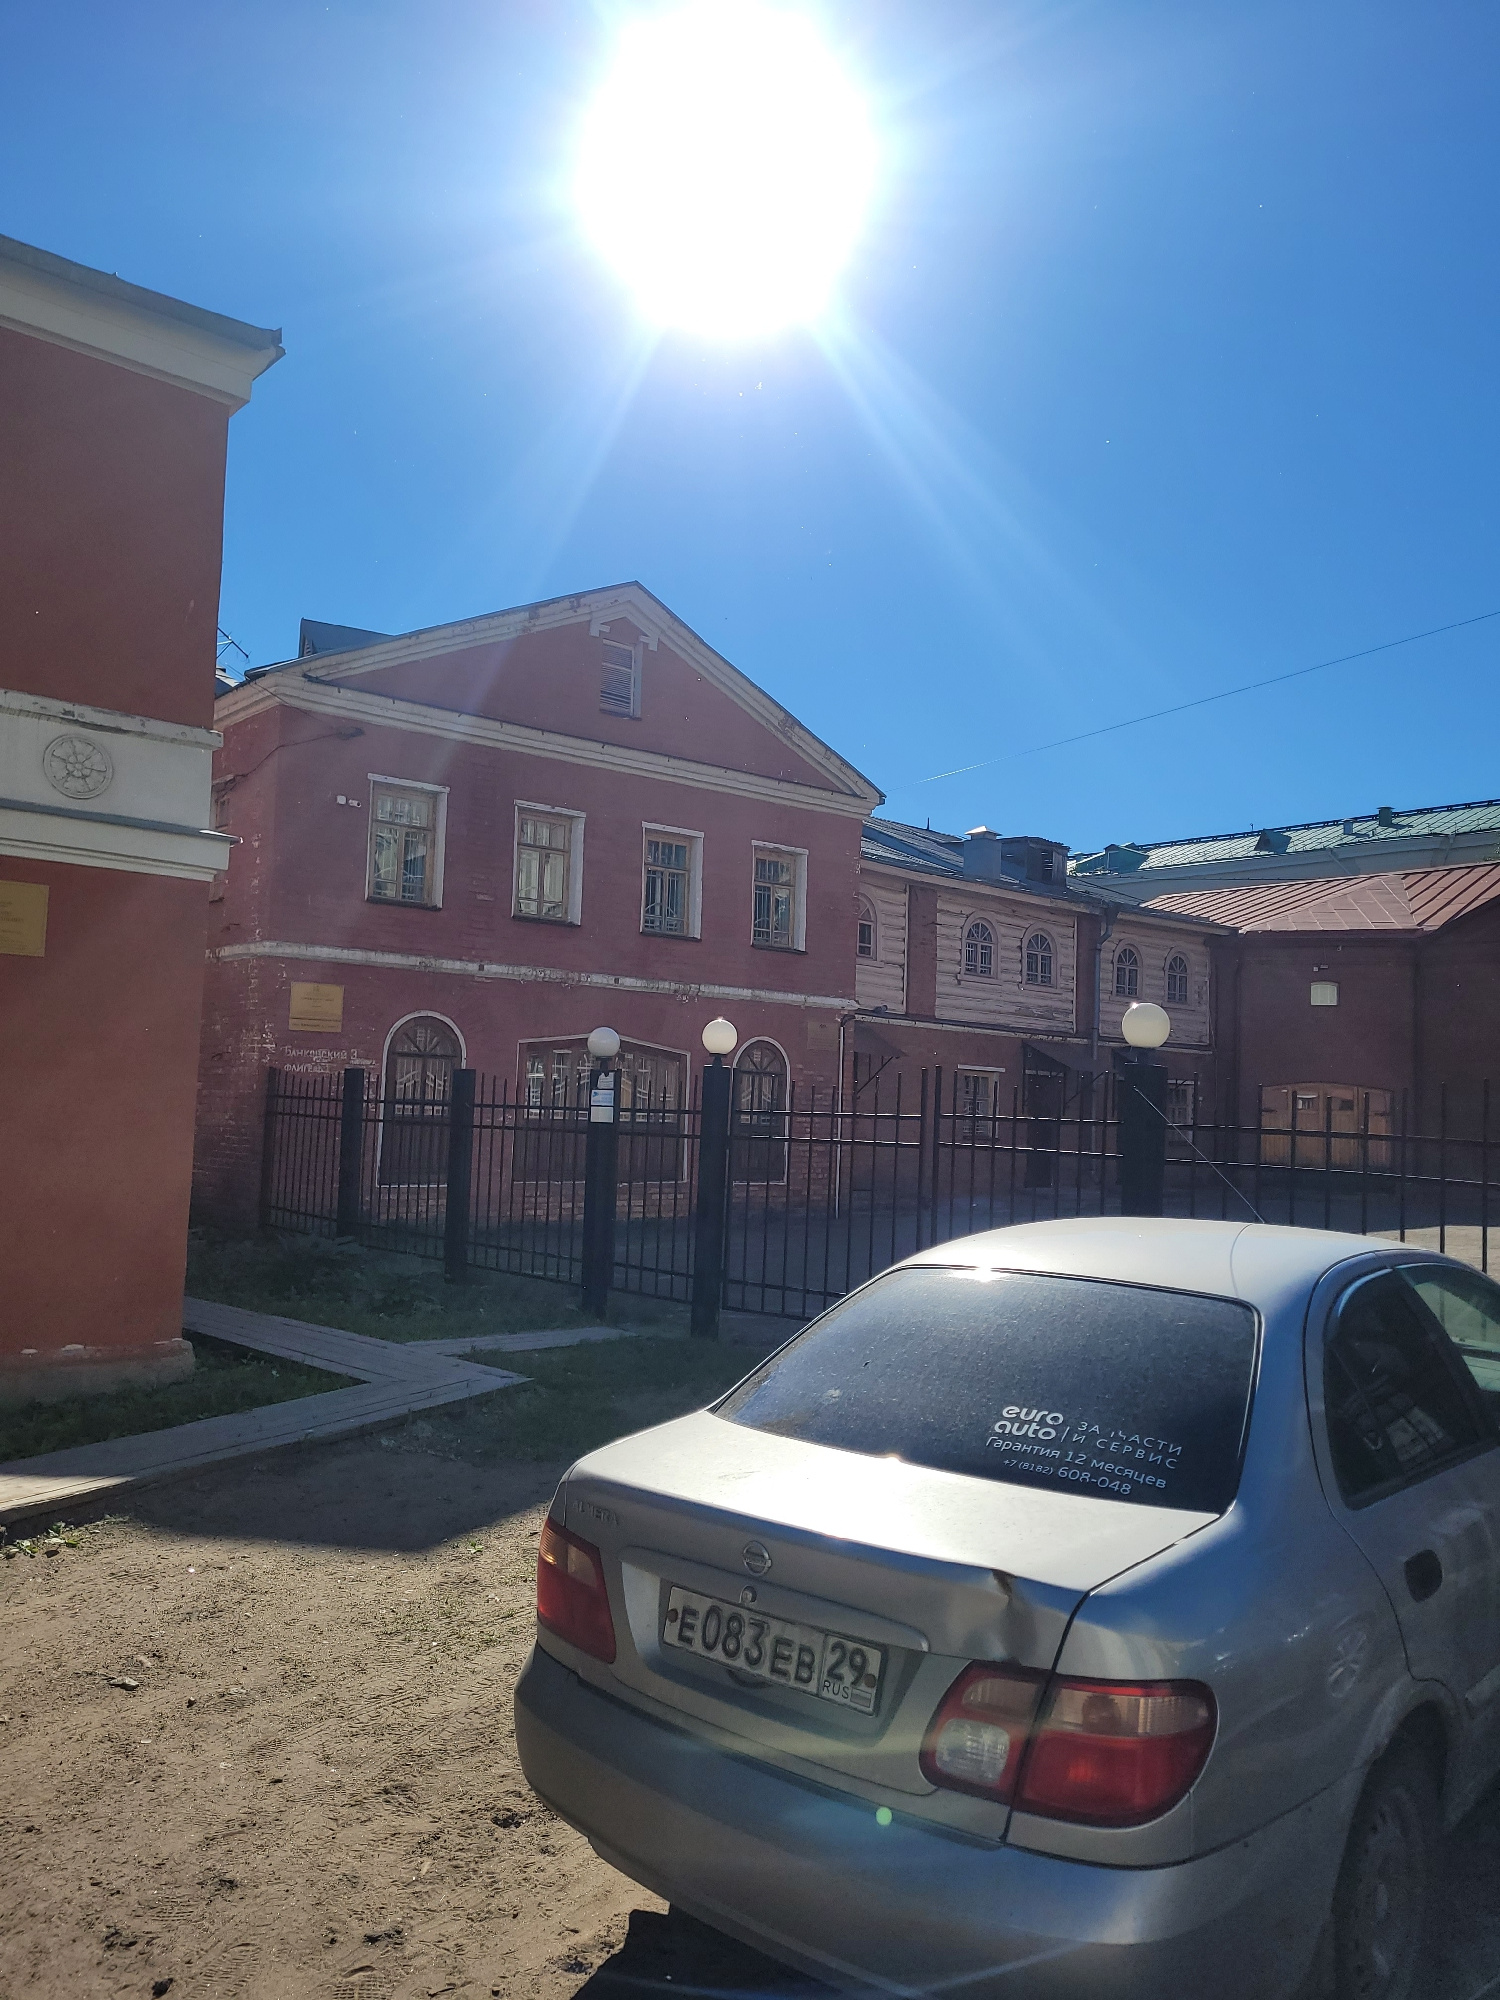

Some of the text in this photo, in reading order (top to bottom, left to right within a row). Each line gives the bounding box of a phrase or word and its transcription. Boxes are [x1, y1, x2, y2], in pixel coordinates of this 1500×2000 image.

[994, 1420, 1057, 1441] auto
[1002, 1405, 1065, 1426] euro
[1072, 1433, 1178, 1470] И СЕРВИС
[1078, 1421, 1183, 1456] ЗАЧАСТИ
[986, 1436, 1168, 1489] Гарантия 12 месяцев
[1003, 1459, 1133, 1495] +7 (8182) 608-048
[826, 1640, 868, 1686] 29
[822, 1679, 849, 1700] RUS
